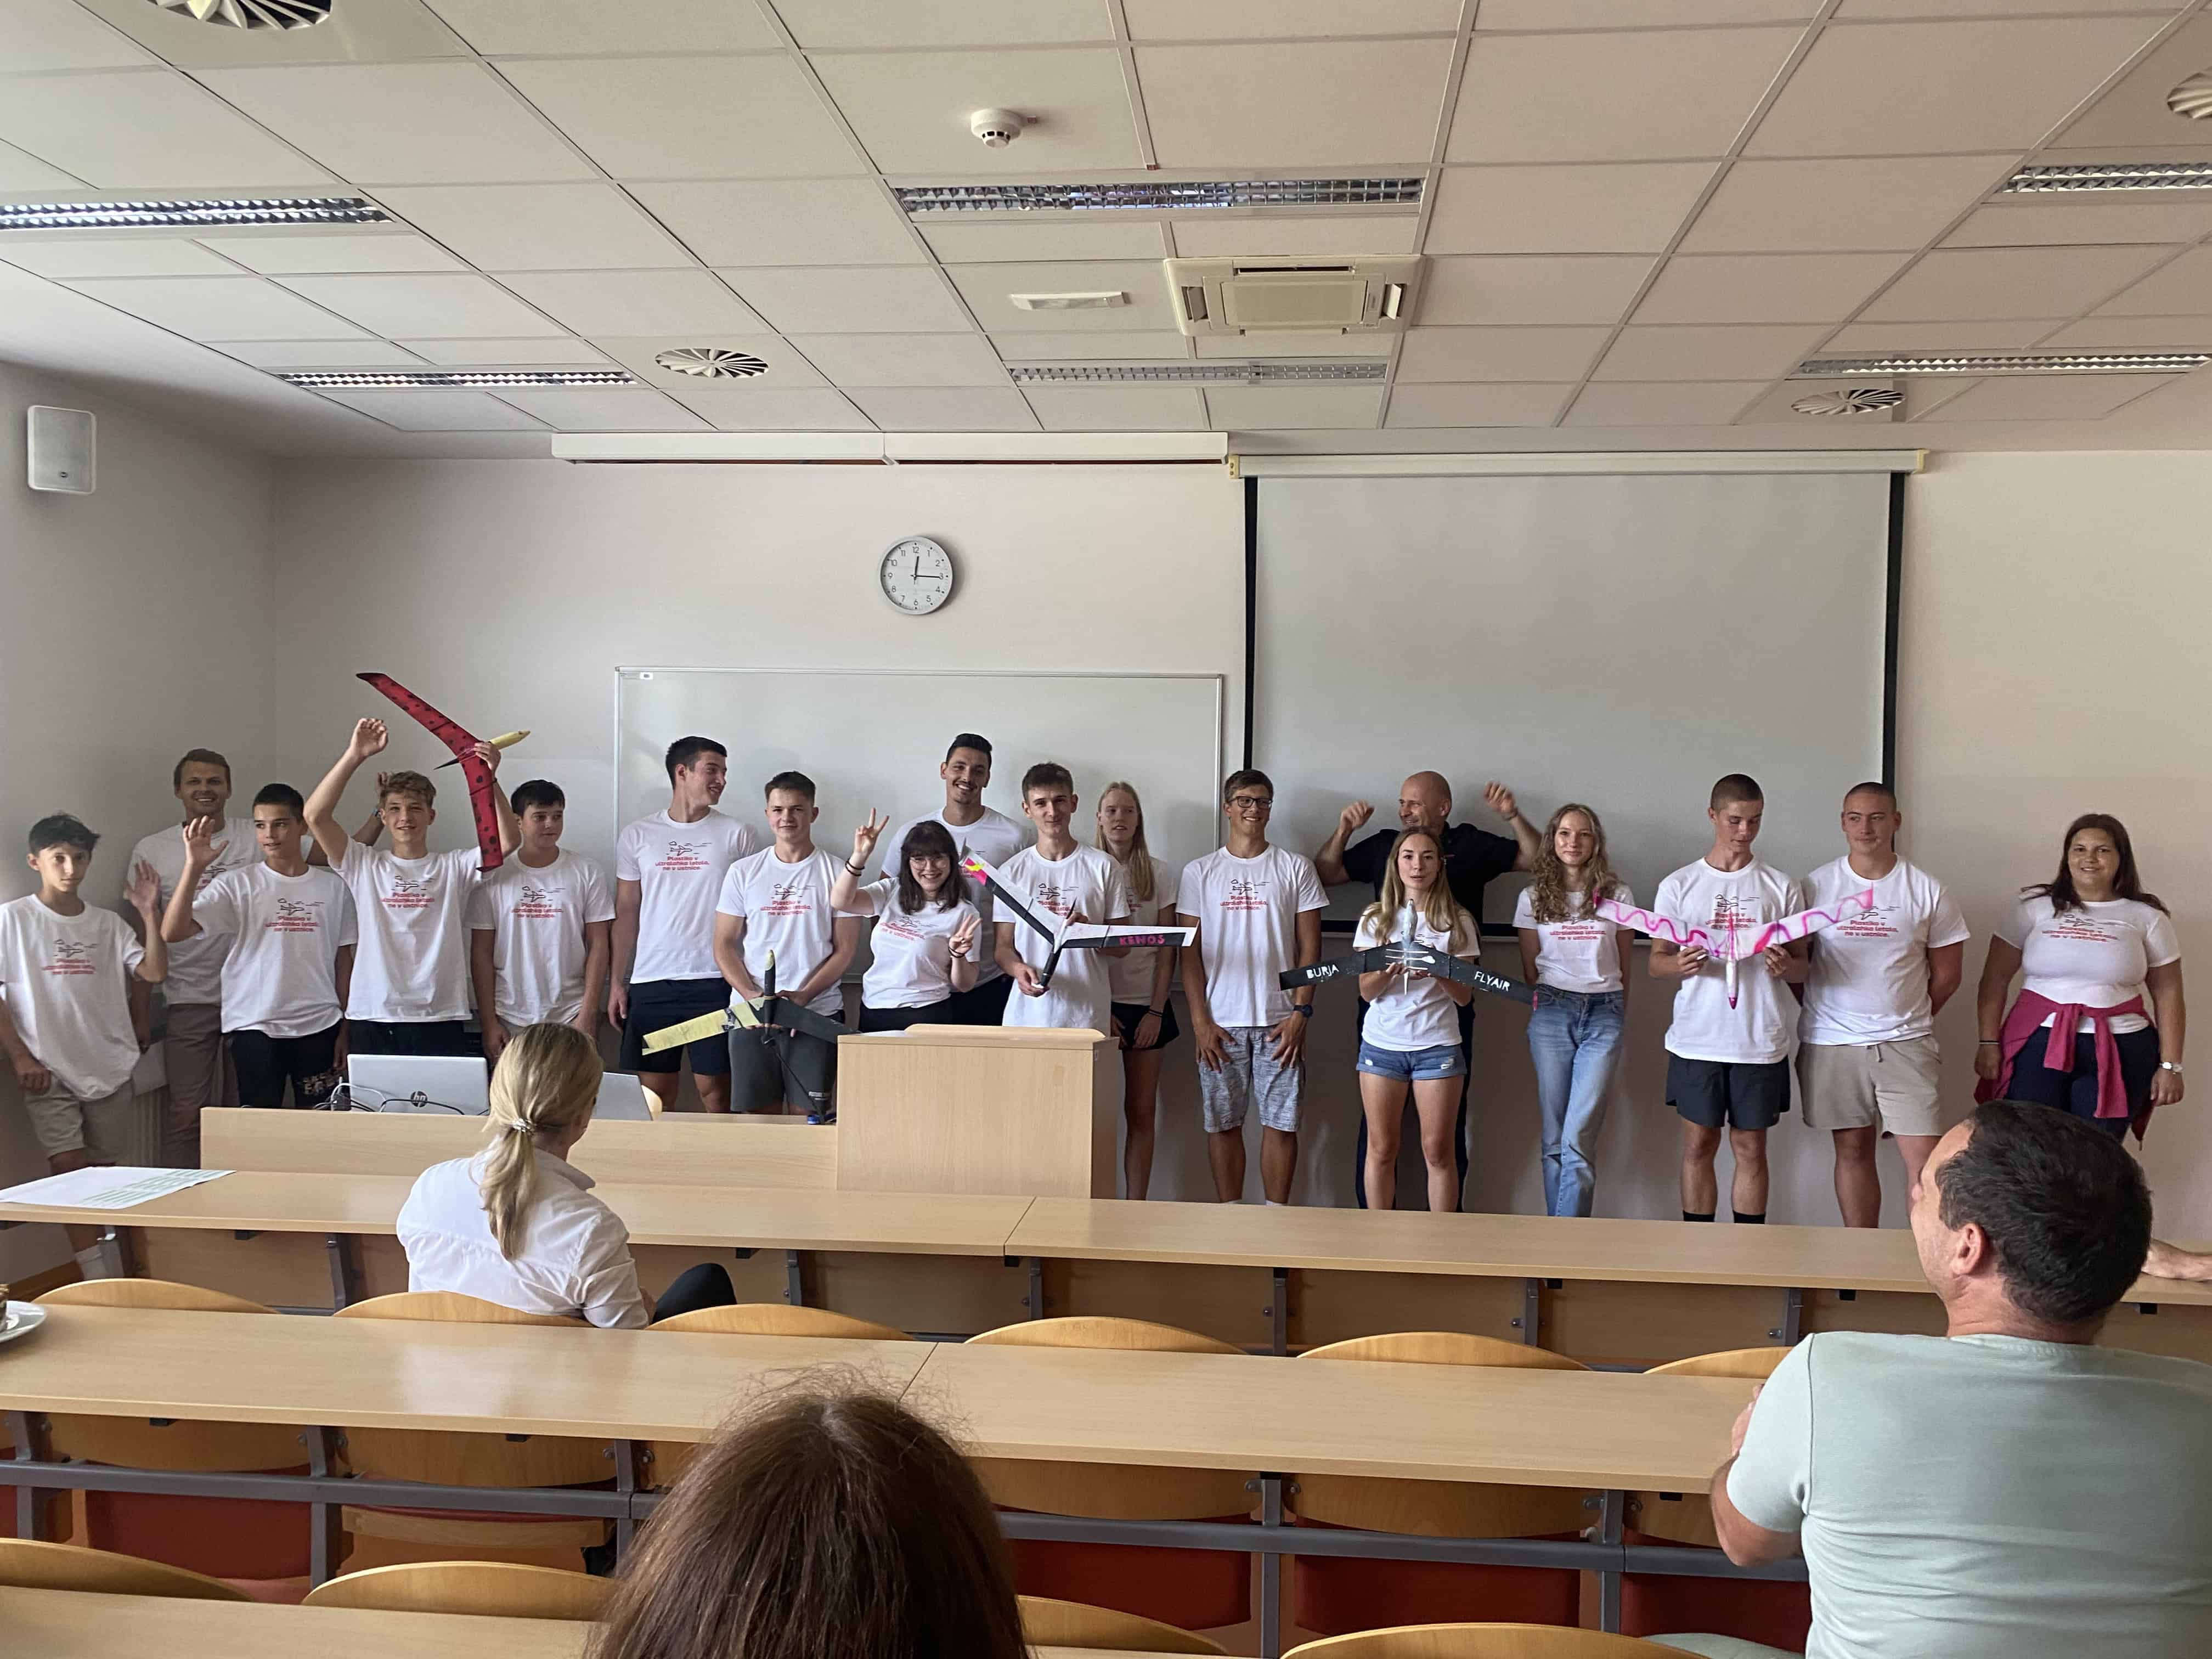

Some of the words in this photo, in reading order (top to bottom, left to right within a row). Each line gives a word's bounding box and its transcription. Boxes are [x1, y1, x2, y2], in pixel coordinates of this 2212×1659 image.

[1120, 934, 1165, 945] KENOS
[1306, 964, 1339, 979] BURJA
[1474, 971, 1510, 991] FLYAIR
[413, 1091, 426, 1107] hp
